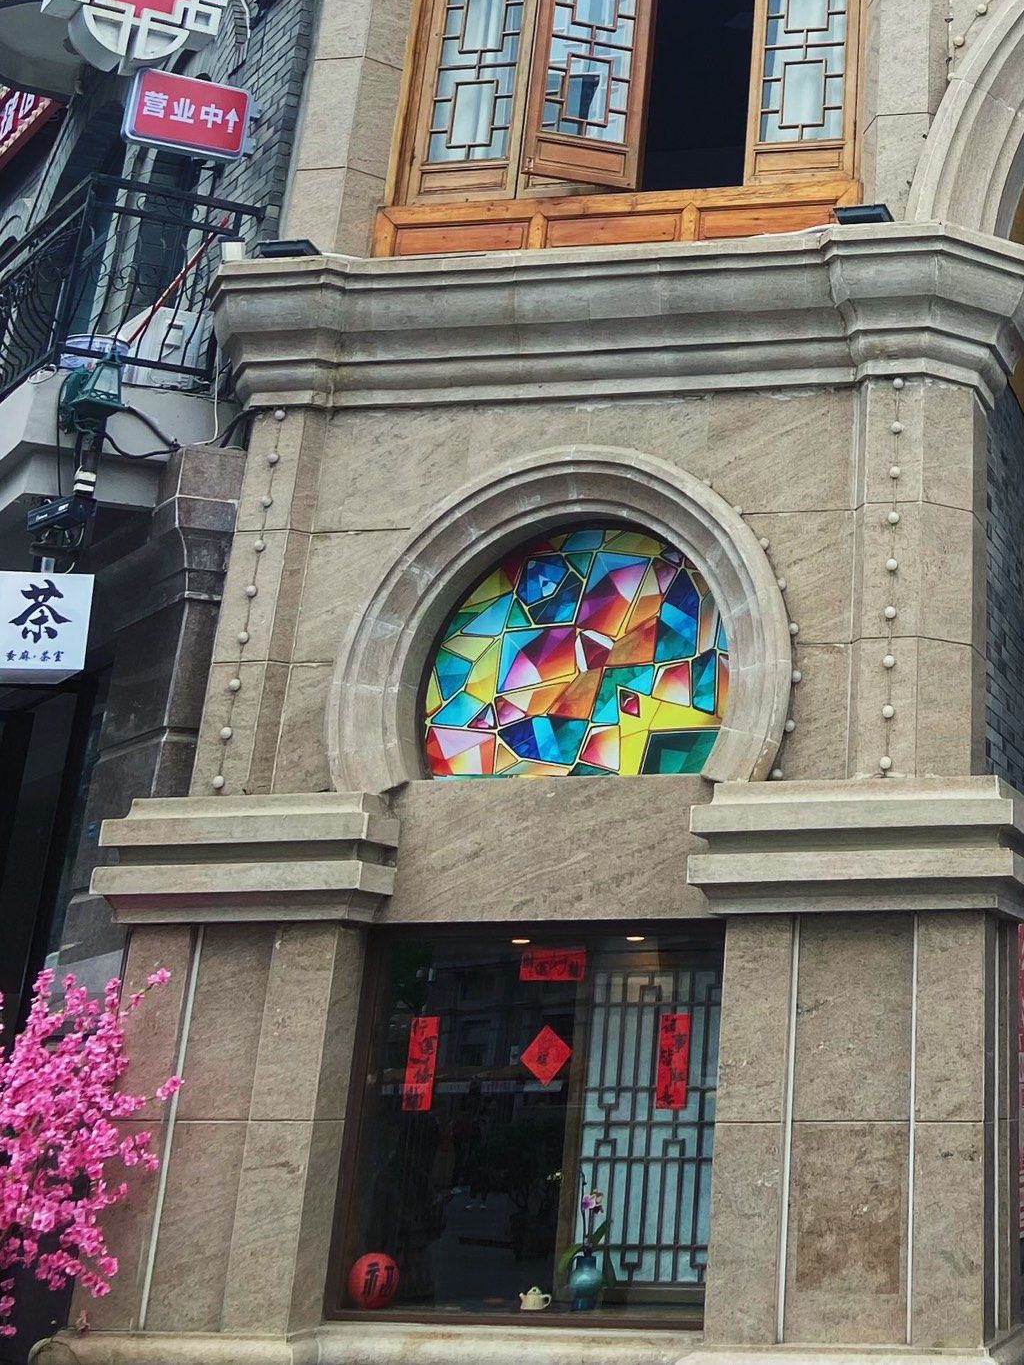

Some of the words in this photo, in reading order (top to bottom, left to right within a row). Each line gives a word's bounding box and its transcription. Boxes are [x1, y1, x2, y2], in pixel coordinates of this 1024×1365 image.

[142, 91, 224, 129] 营业中
[8, 579, 72, 643] 茶
